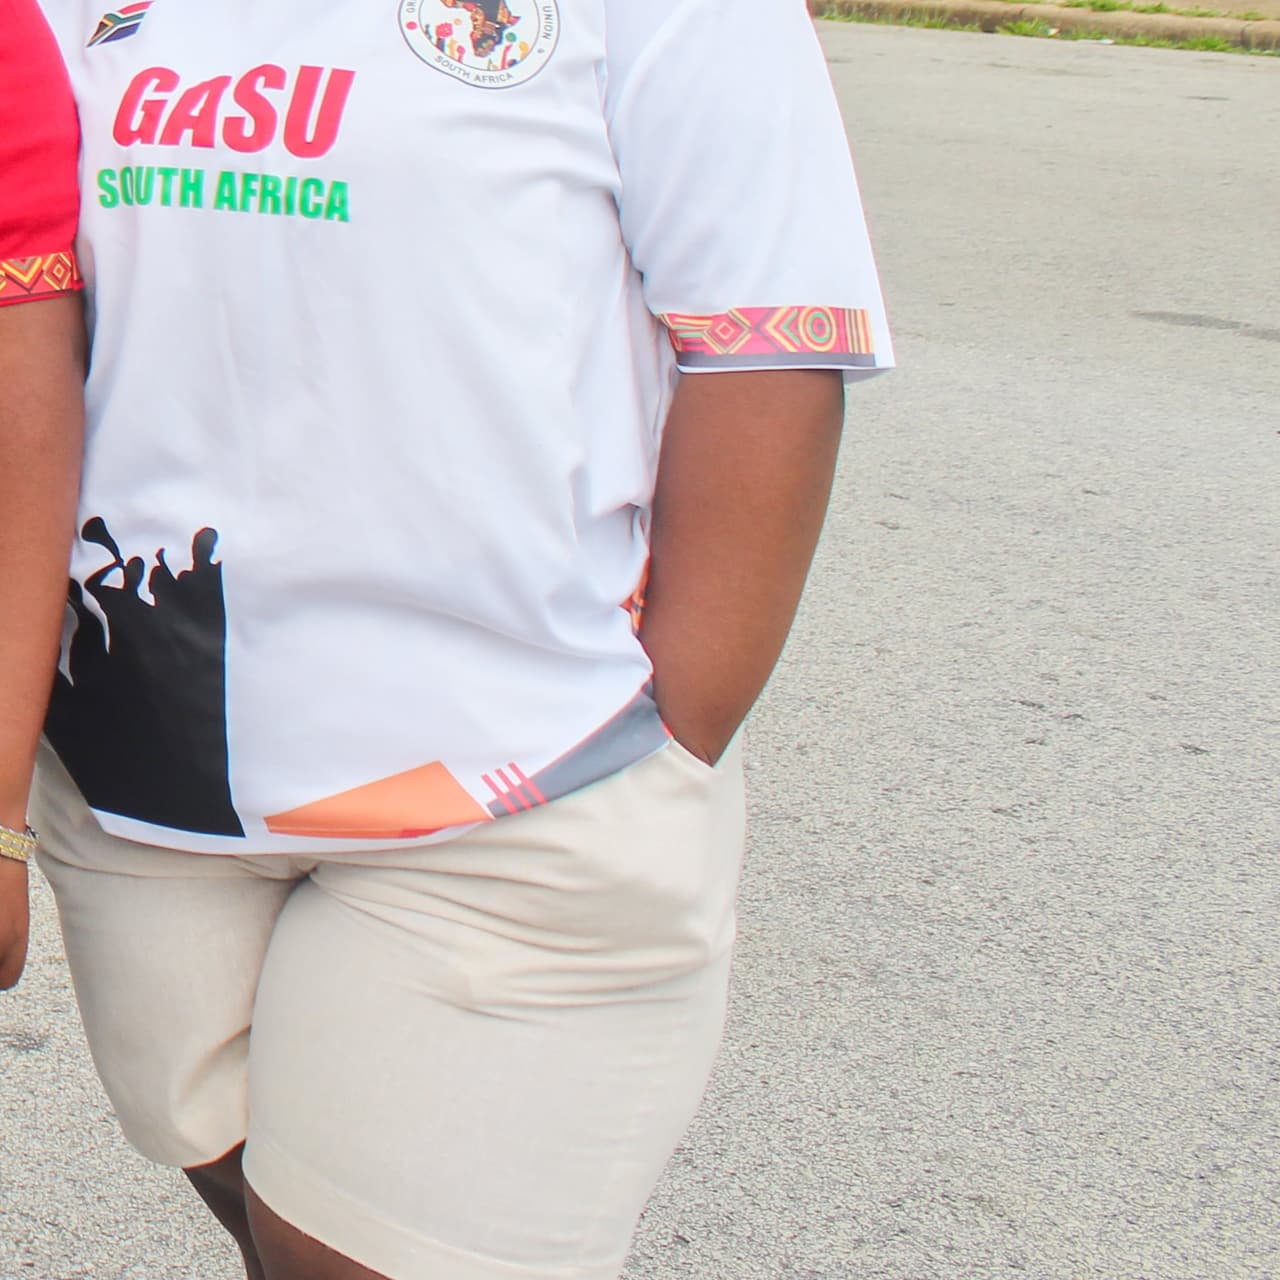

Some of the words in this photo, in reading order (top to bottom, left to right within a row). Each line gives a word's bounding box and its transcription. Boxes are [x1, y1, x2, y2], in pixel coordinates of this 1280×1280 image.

[542, 5, 553, 40] UNION
[434, 55, 471, 79] SOUTH
[474, 72, 513, 84] AFRICA
[113, 63, 356, 159] GASU
[97, 166, 204, 209] SOUTH
[213, 170, 350, 223] AFRICA
